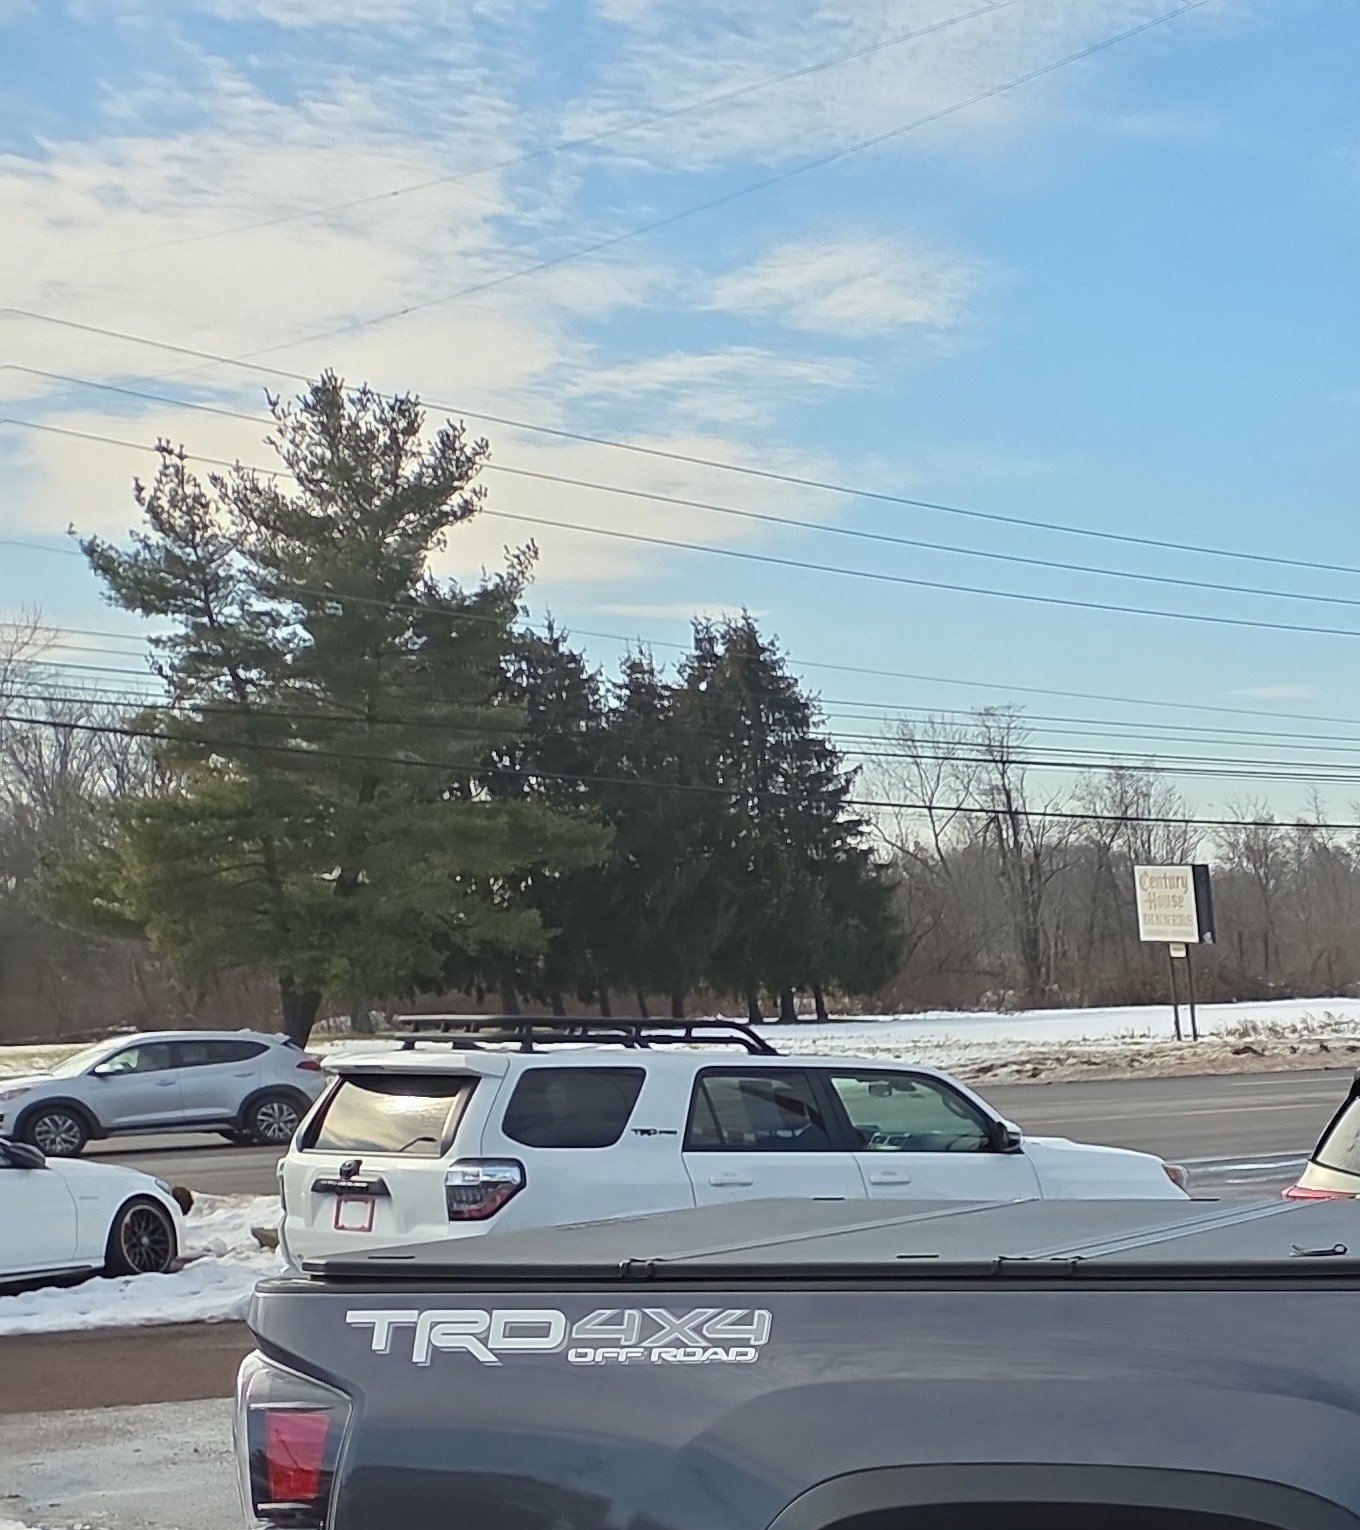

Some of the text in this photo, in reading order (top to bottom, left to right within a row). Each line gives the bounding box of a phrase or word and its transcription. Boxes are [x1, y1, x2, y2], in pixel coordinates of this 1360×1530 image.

[1140, 870, 1188, 894] Century
[1144, 891, 1184, 911] House
[346, 1309, 572, 1366] TRD
[567, 1347, 760, 1365] OFF ROAD
